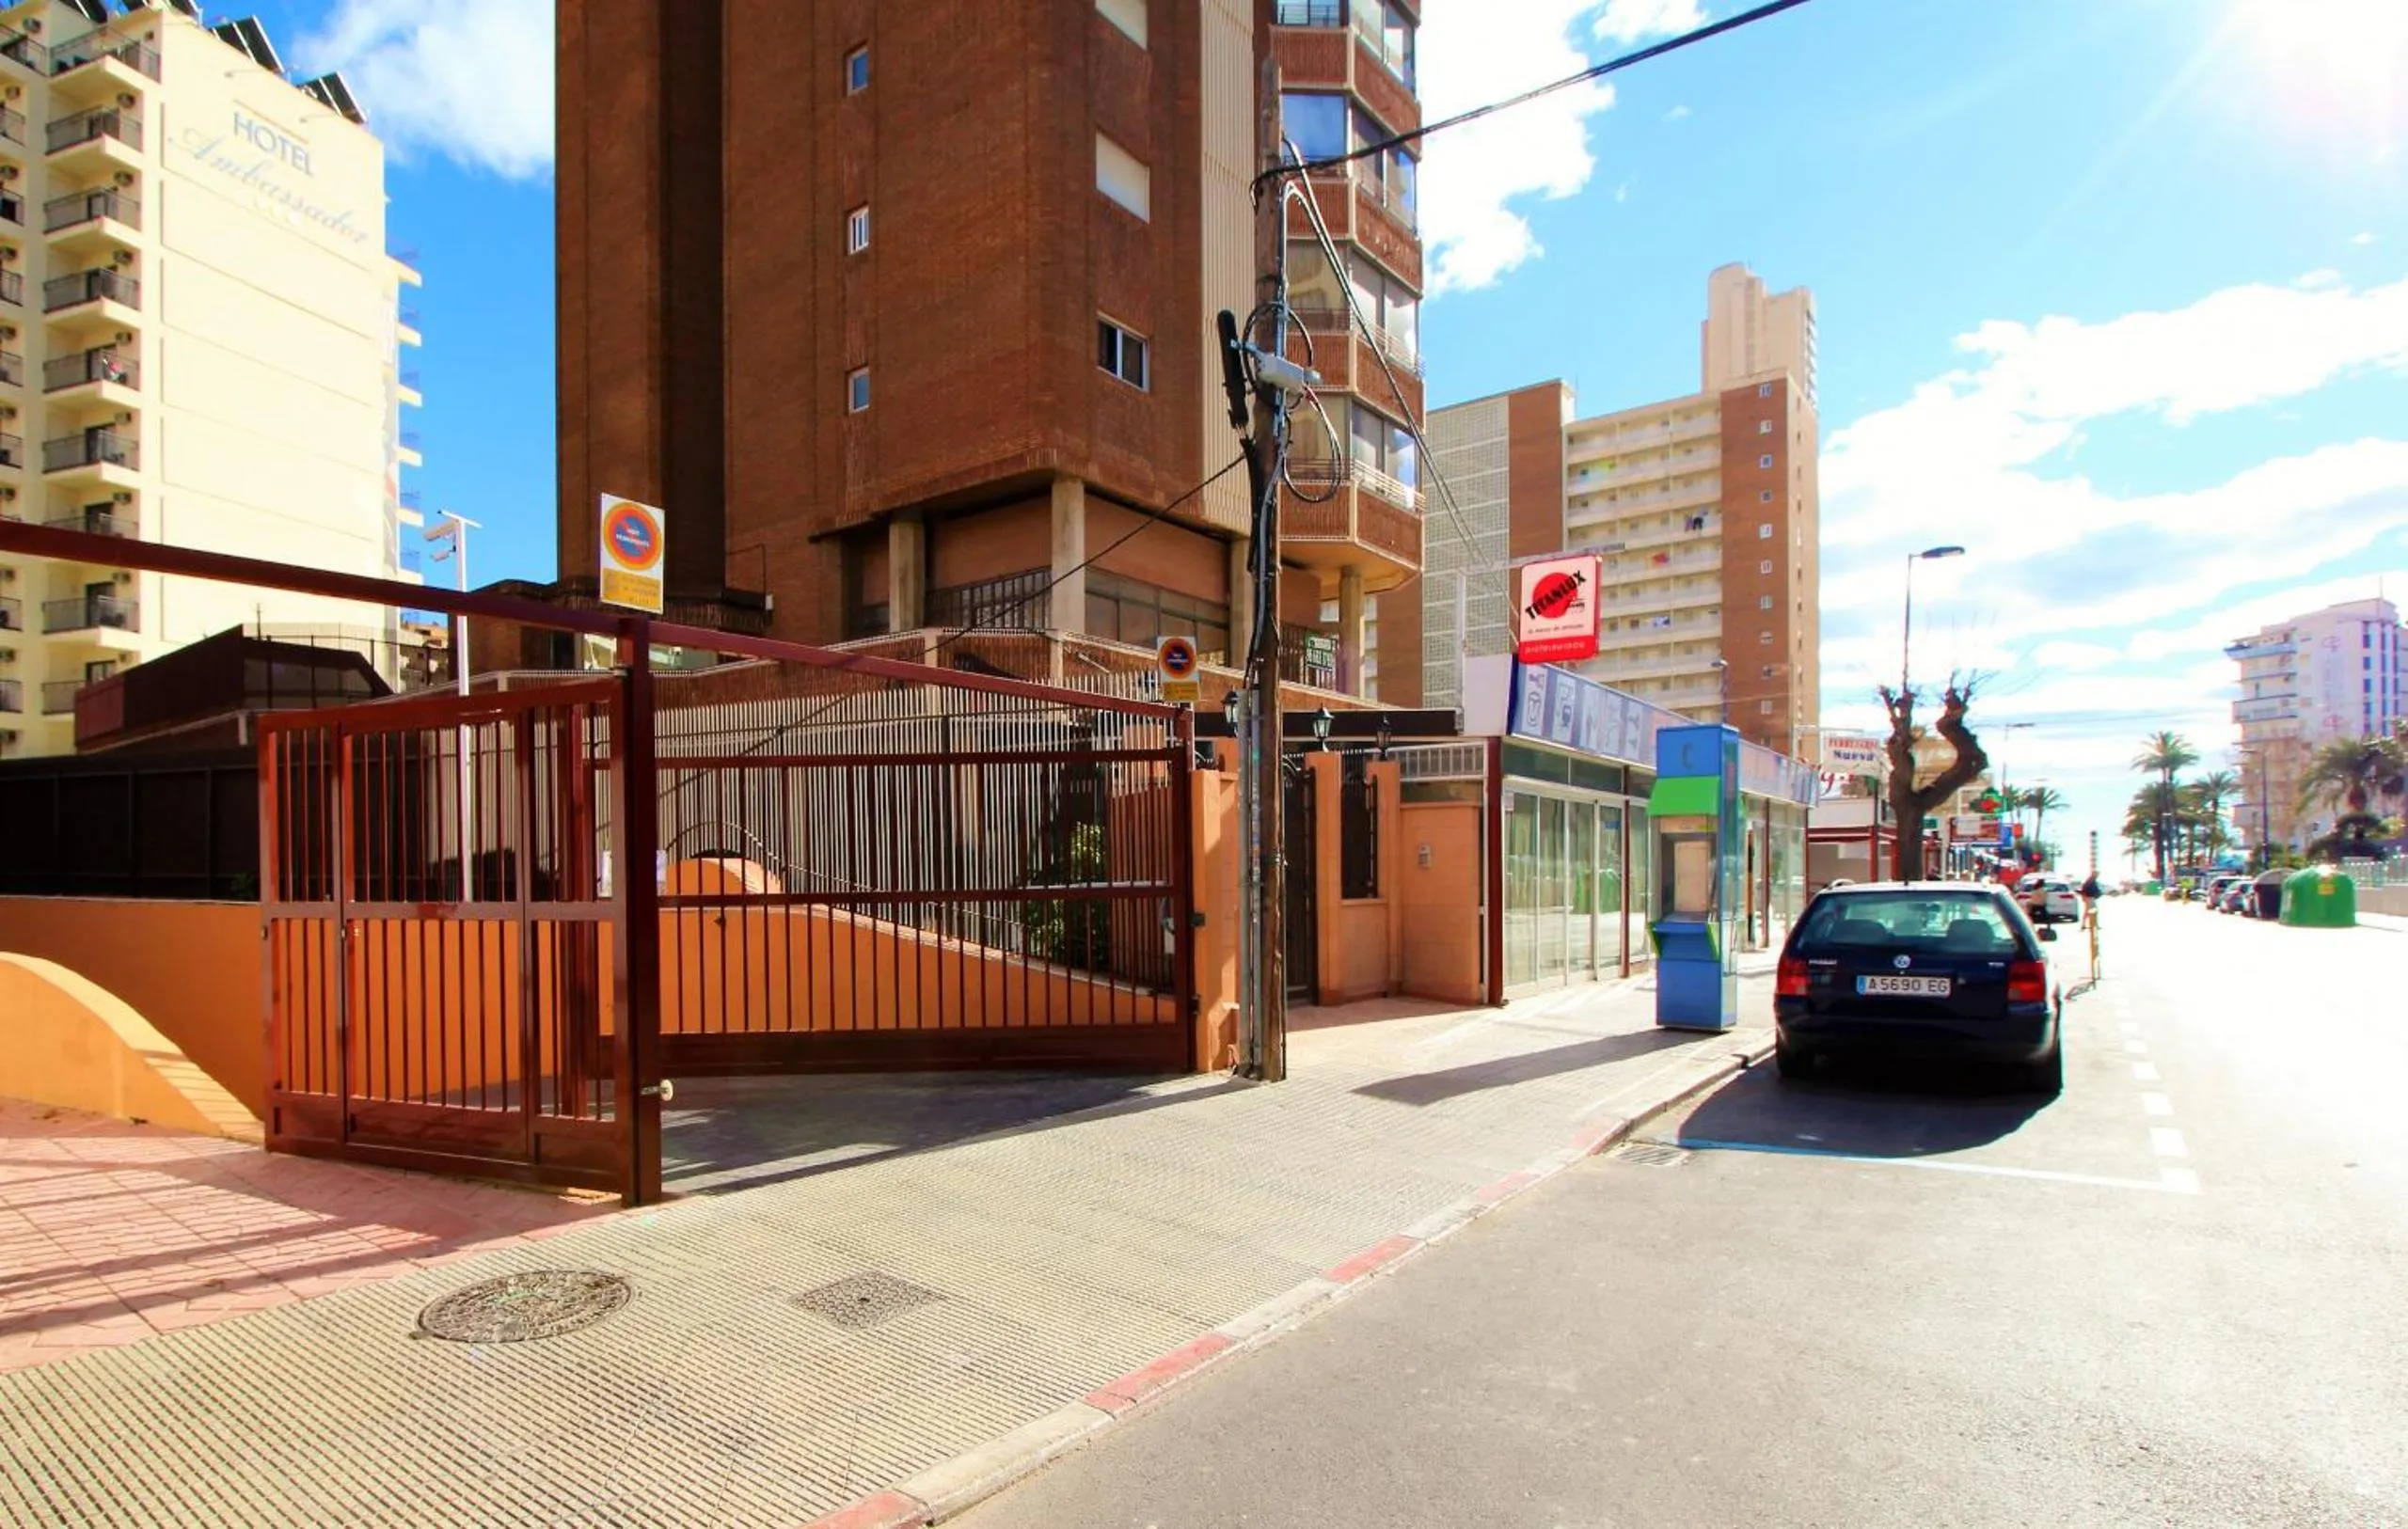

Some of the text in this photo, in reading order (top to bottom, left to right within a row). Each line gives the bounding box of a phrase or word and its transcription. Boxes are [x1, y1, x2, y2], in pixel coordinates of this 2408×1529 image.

[233, 111, 313, 178] HOTEL
[166, 127, 370, 244] Ambassador
[1525, 569, 1587, 621] TITANLUX
[1868, 977, 1947, 993] A 5690 EG
